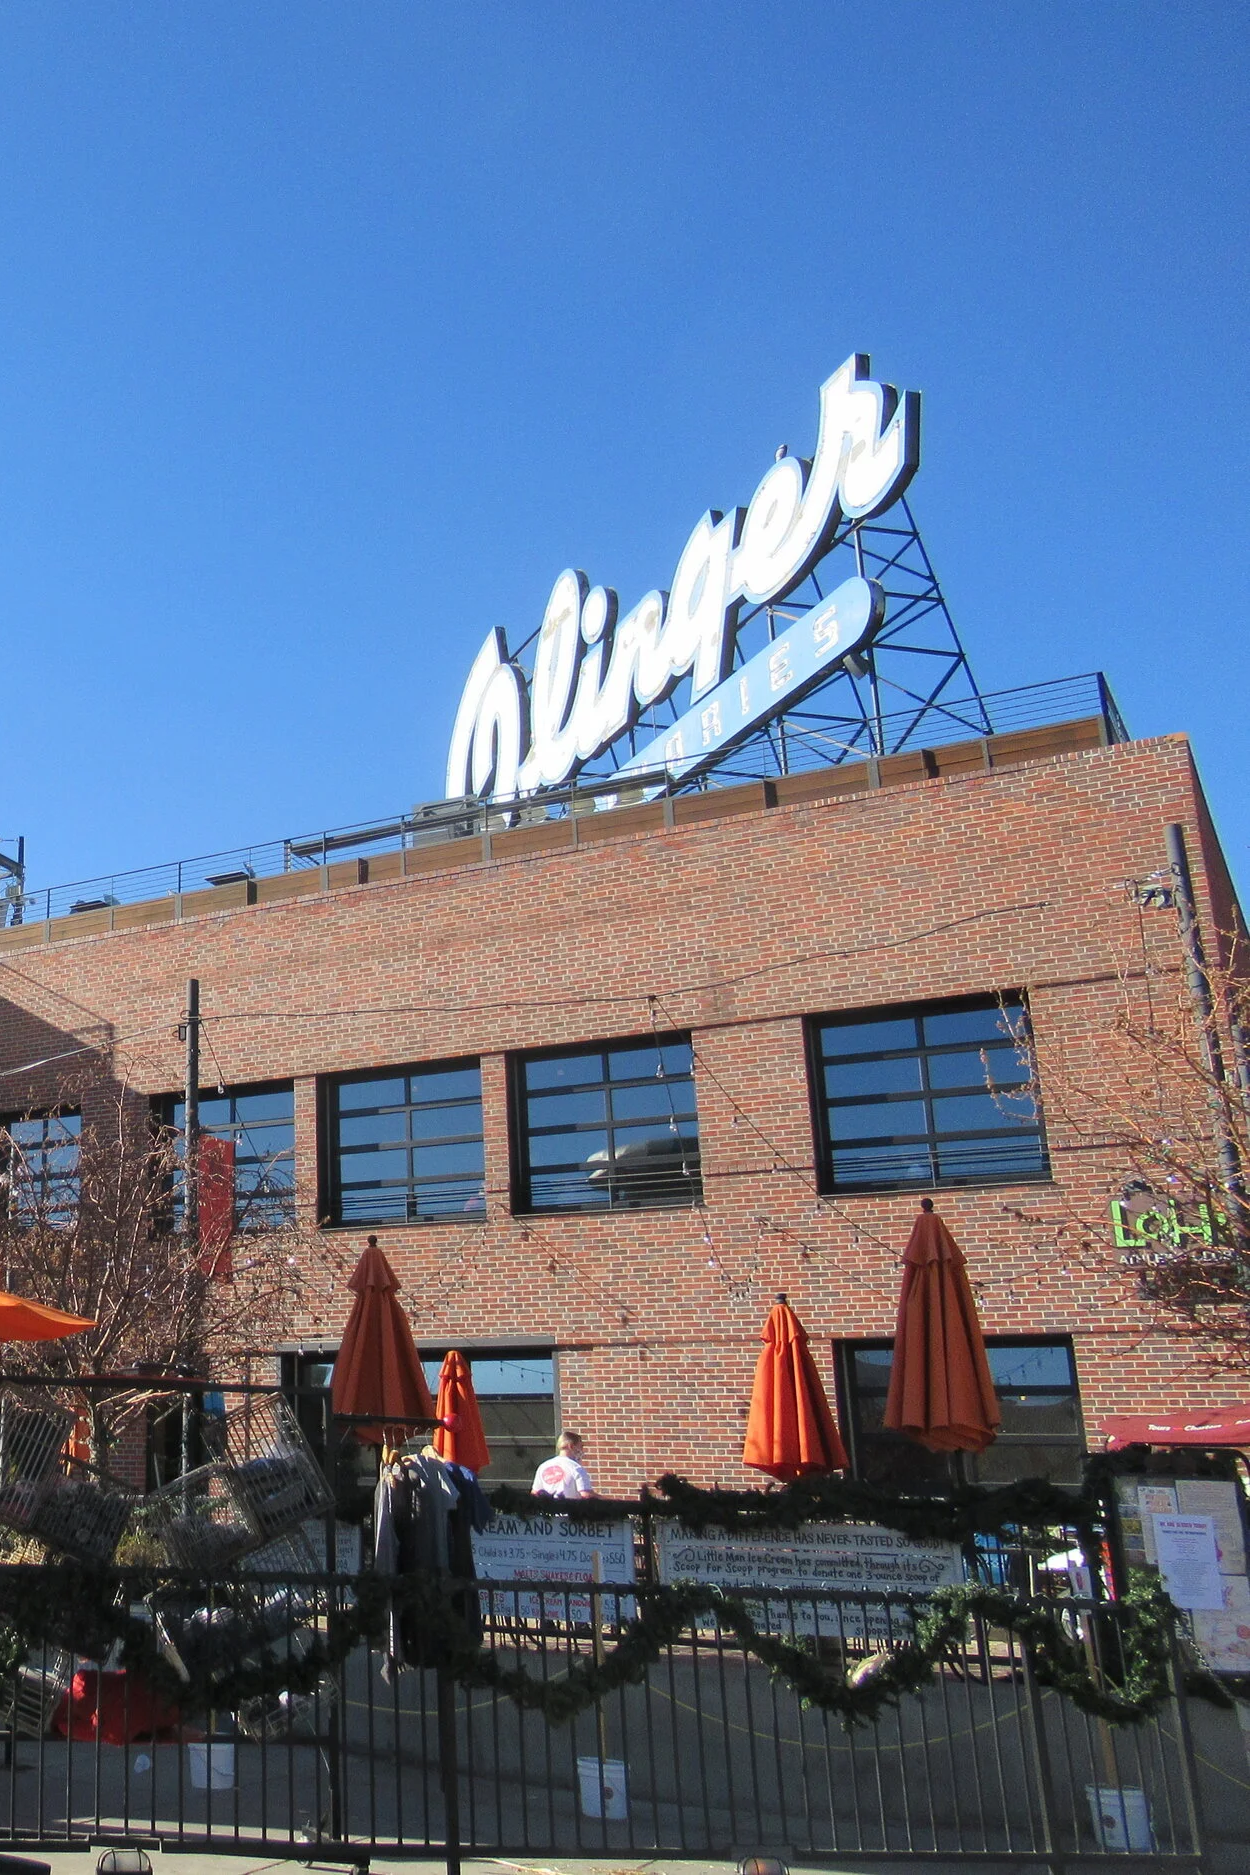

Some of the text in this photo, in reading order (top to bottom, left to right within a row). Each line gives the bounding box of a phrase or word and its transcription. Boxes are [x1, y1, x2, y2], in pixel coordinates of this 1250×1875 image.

[524, 1520, 553, 1536] AND
[559, 1521, 615, 1538] SORBET
[670, 1528, 716, 1540] MAKING
[717, 1528, 726, 1540] A
[728, 1529, 791, 1543] DIFFERENCE
[793, 1532, 814, 1545] HAS
[817, 1533, 851, 1545] NEVER
[854, 1534, 893, 1547] TASTED
[896, 1537, 910, 1548] SO
[673, 1561, 700, 1573] Scoop
[725, 1562, 753, 1575] Scoop
[798, 1567, 808, 1576] to
[812, 1567, 843, 1578] donate
[846, 1571, 862, 1579] one
[697, 1551, 723, 1561] Little
[725, 1552, 746, 1562] Man
[864, 1557, 900, 1574] through
[801, 1609, 812, 1620] to
